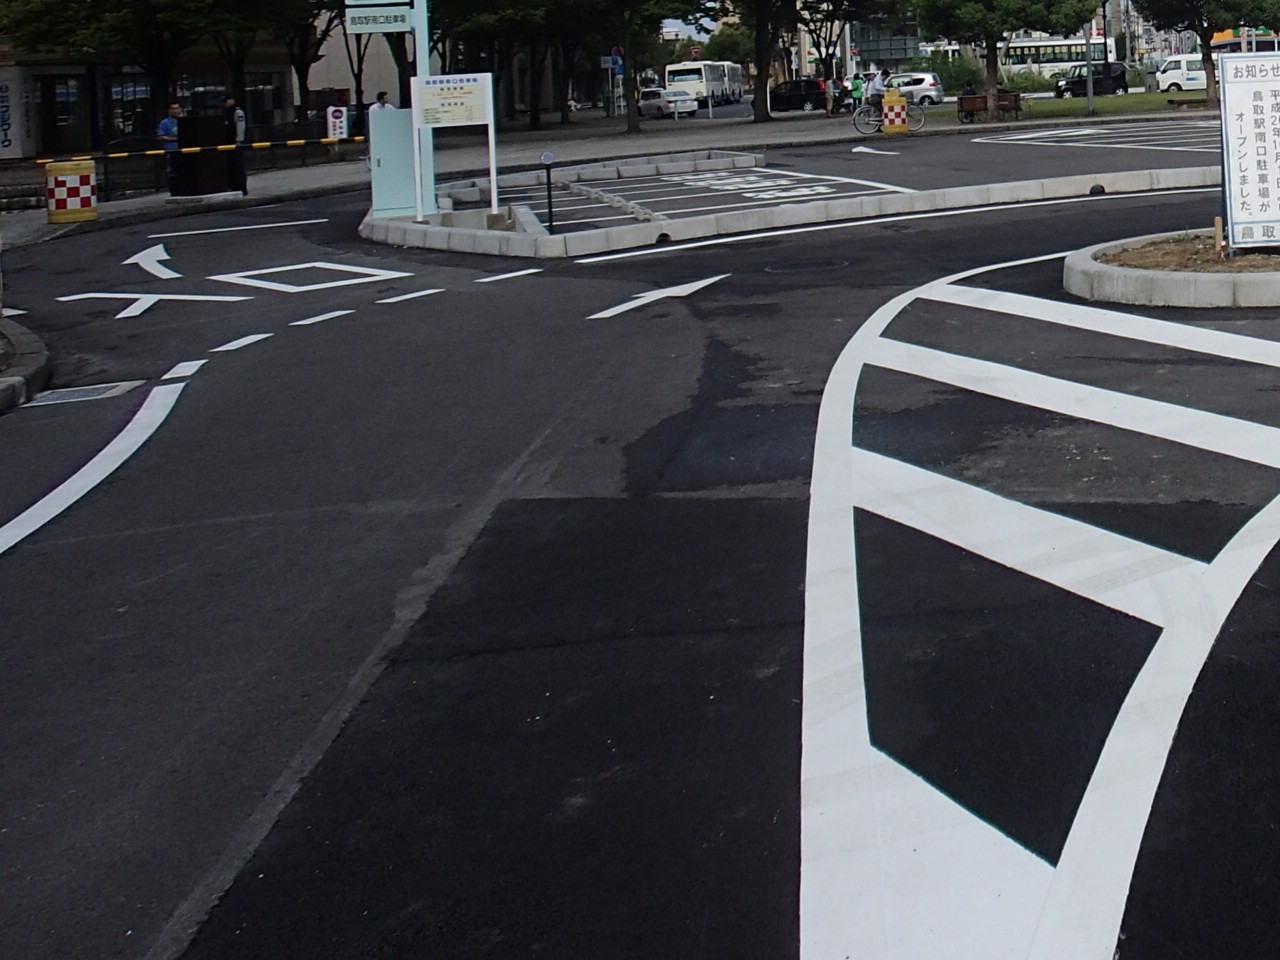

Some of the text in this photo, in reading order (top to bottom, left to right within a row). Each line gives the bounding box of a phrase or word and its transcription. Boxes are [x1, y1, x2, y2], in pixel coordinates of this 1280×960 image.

[1235, 111, 1253, 217] オープンしました。
[1252, 90, 1271, 214] 鳥取駅南口駐車場が
